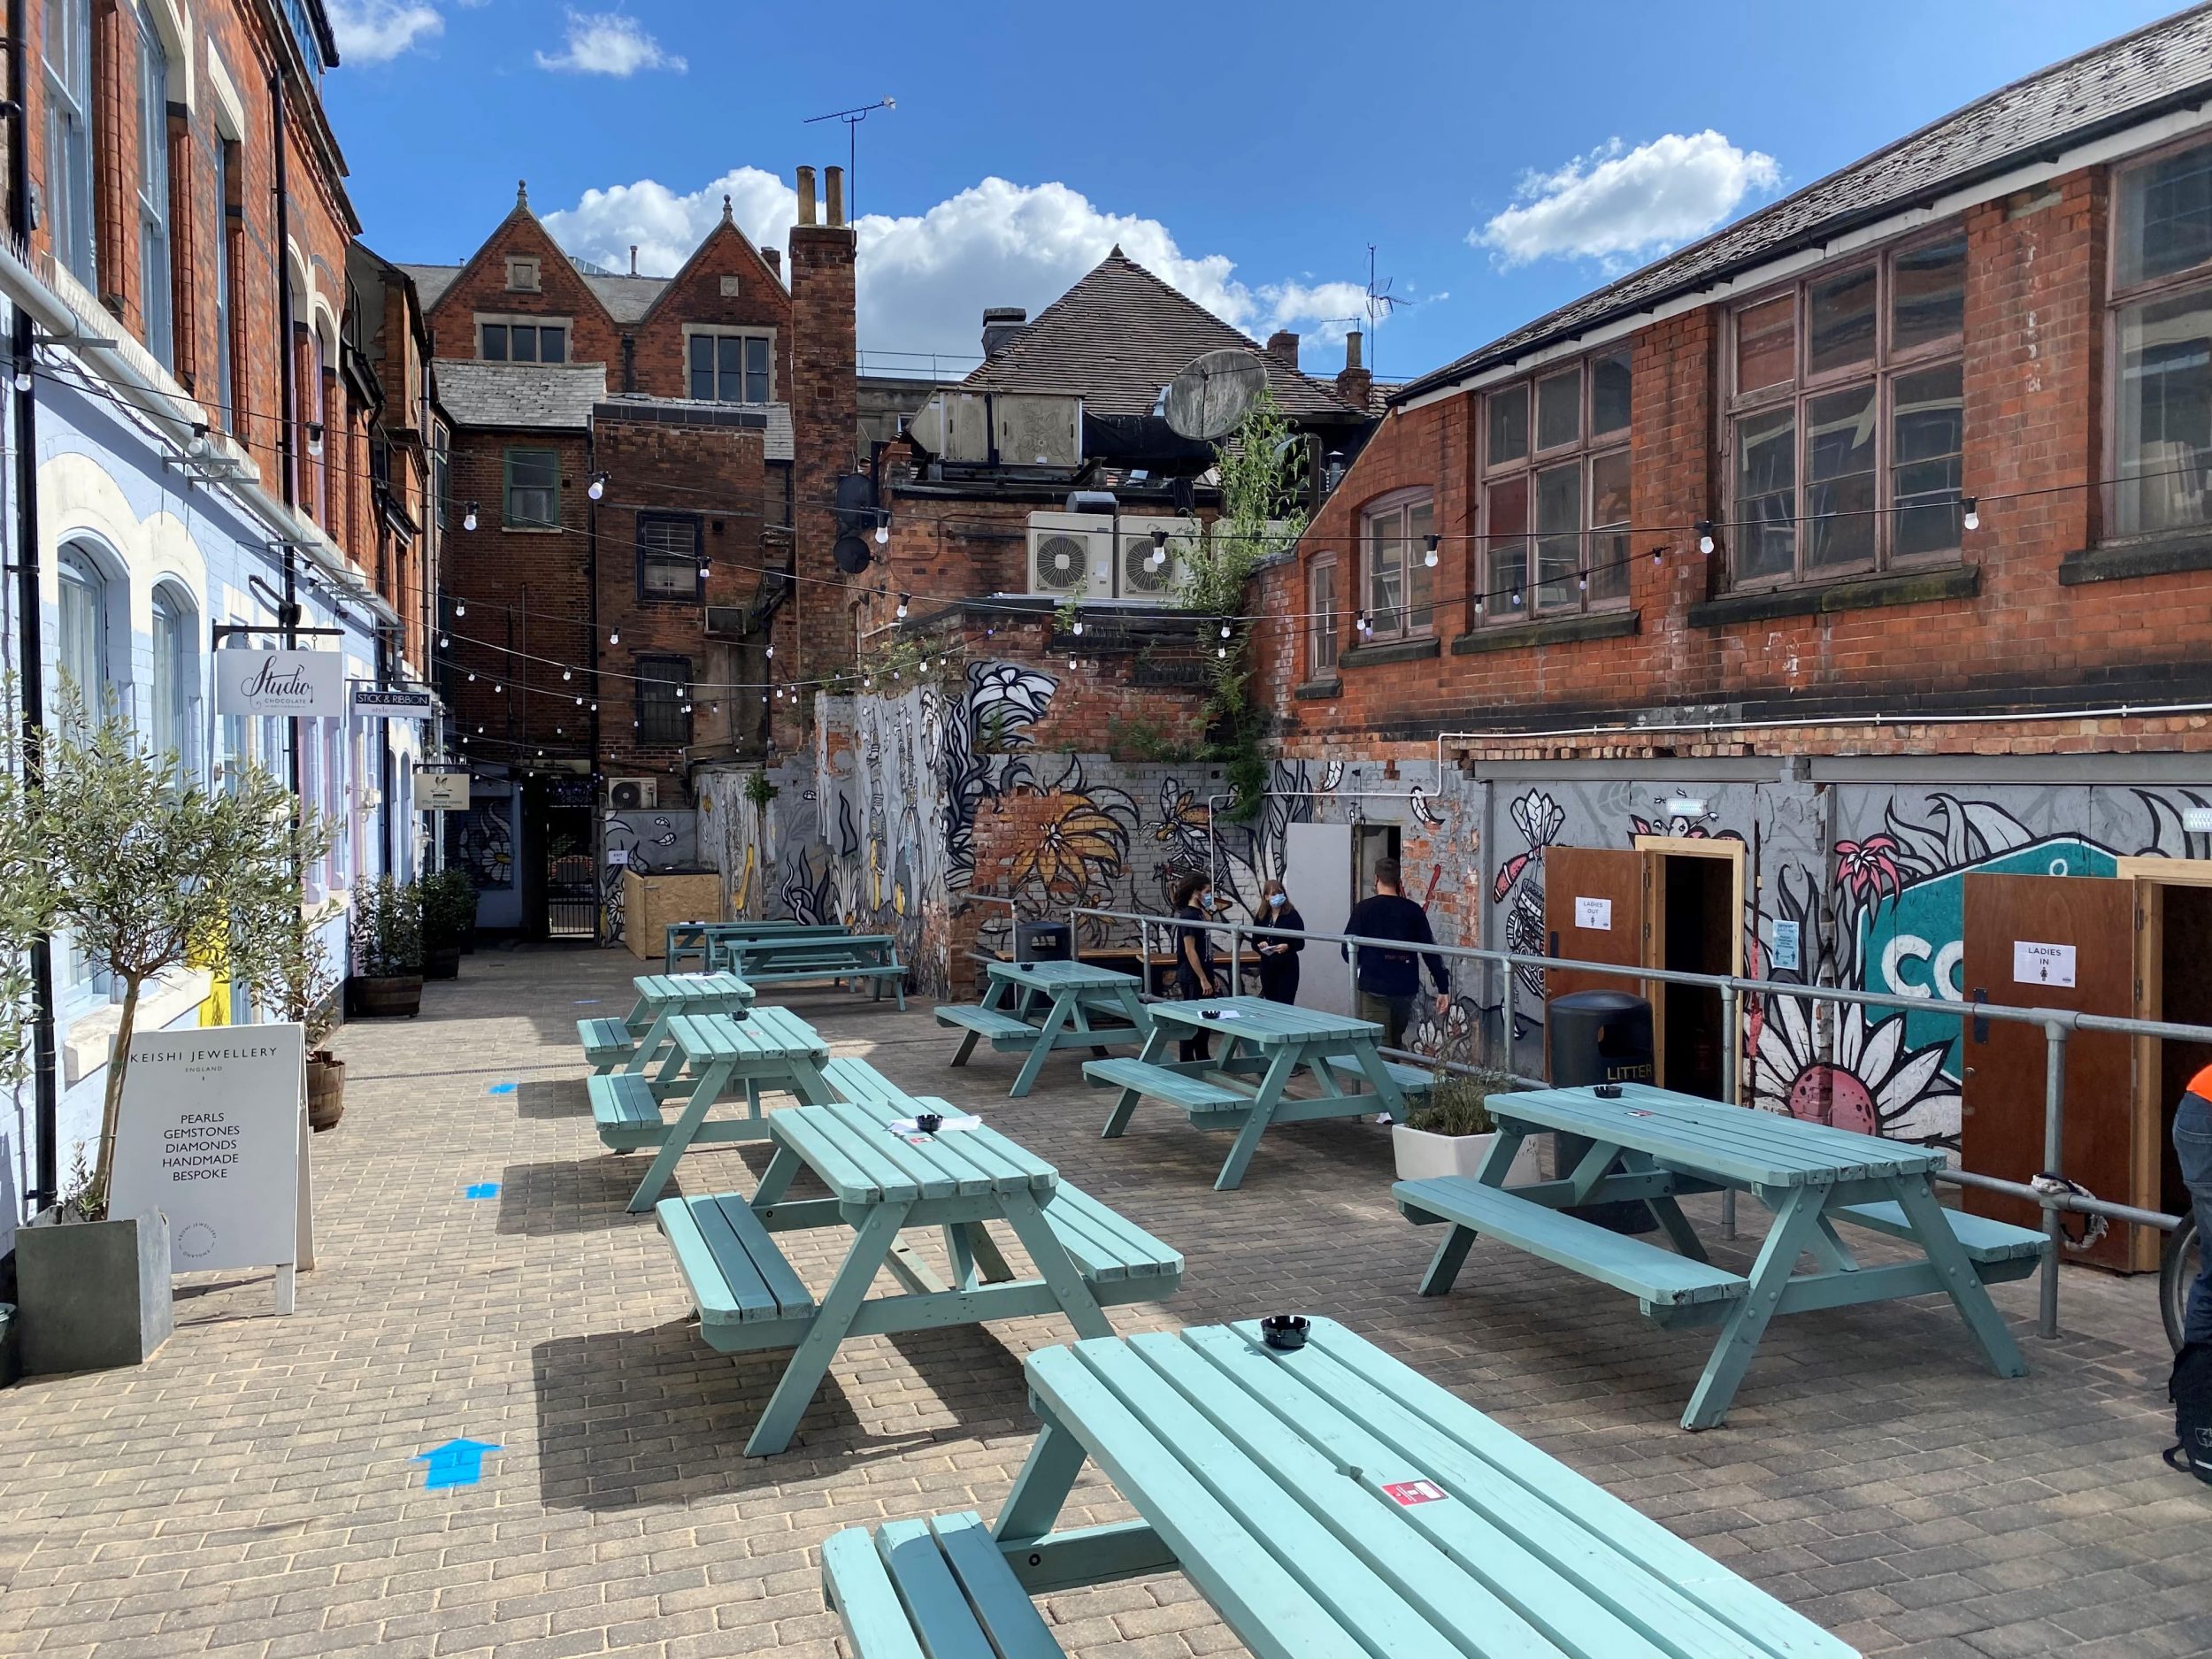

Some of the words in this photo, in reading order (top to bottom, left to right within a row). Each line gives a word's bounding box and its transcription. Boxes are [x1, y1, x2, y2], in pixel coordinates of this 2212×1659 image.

[241, 655, 313, 706] Studio
[357, 694, 381, 703] STICK
[383, 695, 390, 703] &
[392, 695, 427, 704] RIBBON
[2028, 947, 2062, 956] LADIES
[130, 1051, 182, 1063] KEISHI
[190, 1047, 277, 1063] JEWELLERY
[1607, 1064, 1652, 1080] LITTER
[180, 1112, 225, 1125] PEARLS
[164, 1125, 240, 1140] GEMSTONES
[165, 1140, 237, 1154] DIAMONDS
[162, 1154, 239, 1168] HANDMADE
[173, 1168, 227, 1181] BESPOKE
